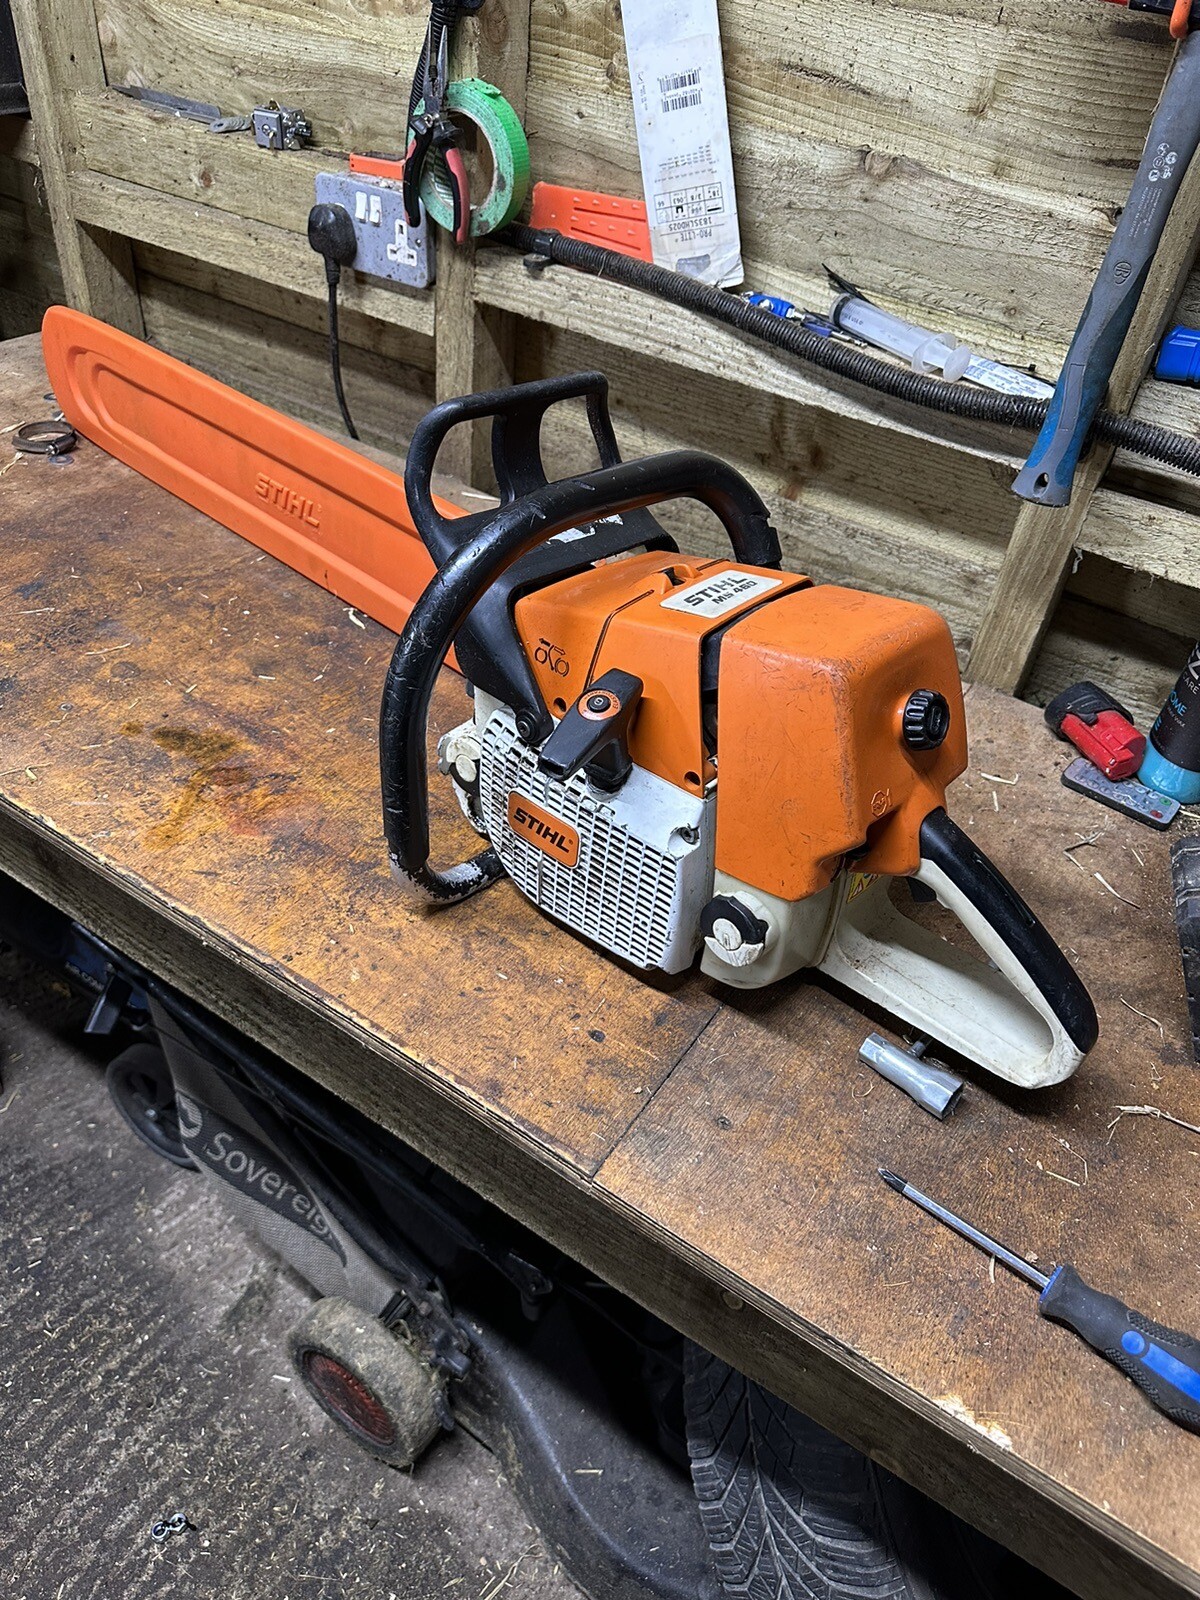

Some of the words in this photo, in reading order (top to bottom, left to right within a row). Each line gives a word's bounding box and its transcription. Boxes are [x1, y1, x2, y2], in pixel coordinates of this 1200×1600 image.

[254, 471, 321, 529] STIHL
[683, 576, 749, 607] STIHL
[711, 593, 735, 605] MS
[734, 579, 758, 594] 460
[1168, 688, 1188, 717] OME
[513, 806, 570, 854] STIHL
